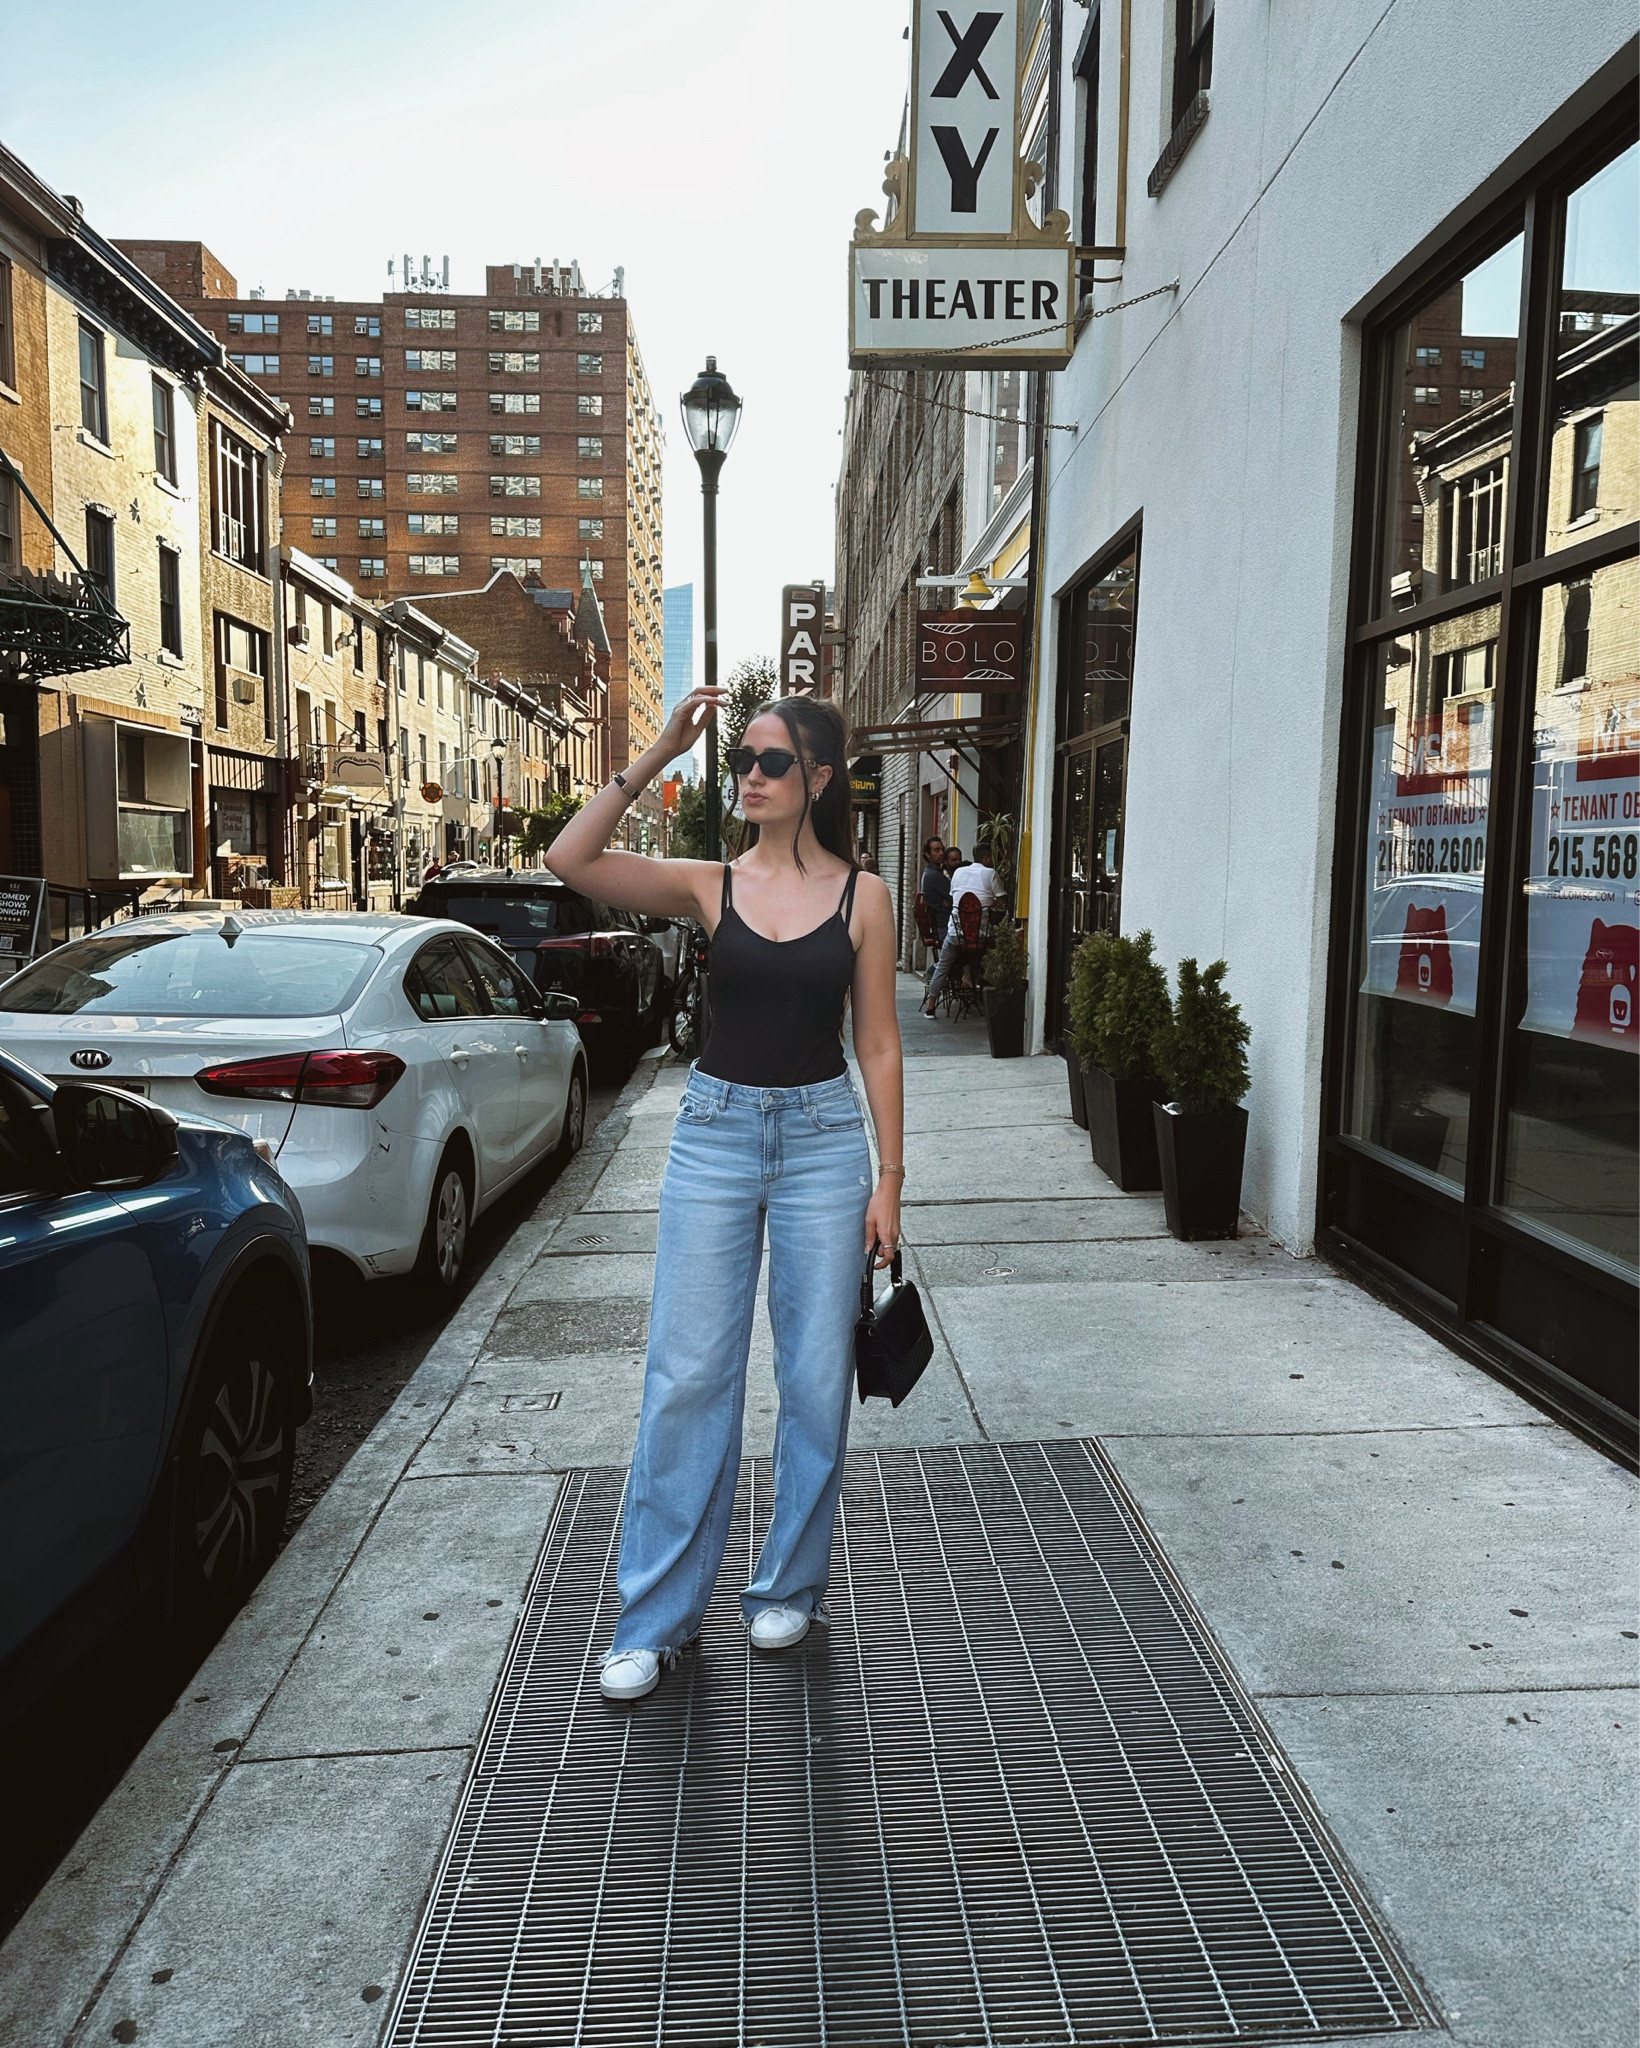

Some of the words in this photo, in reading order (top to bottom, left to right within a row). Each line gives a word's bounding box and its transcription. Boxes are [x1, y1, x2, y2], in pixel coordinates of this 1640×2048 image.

[930, 10, 1004, 213] XY
[863, 279, 1059, 320] THEATER
[922, 640, 1015, 663] BOLO
[1388, 806, 1424, 828] TENANT
[1426, 803, 1476, 826] OBTAINED
[1563, 793, 1618, 821] TENANT
[1379, 837, 1484, 873] 21.568.2600
[1548, 834, 1638, 879] 215.568
[1547, 890, 1615, 902] HELLOMSC.COM
[76, 1052, 104, 1065] KIA
